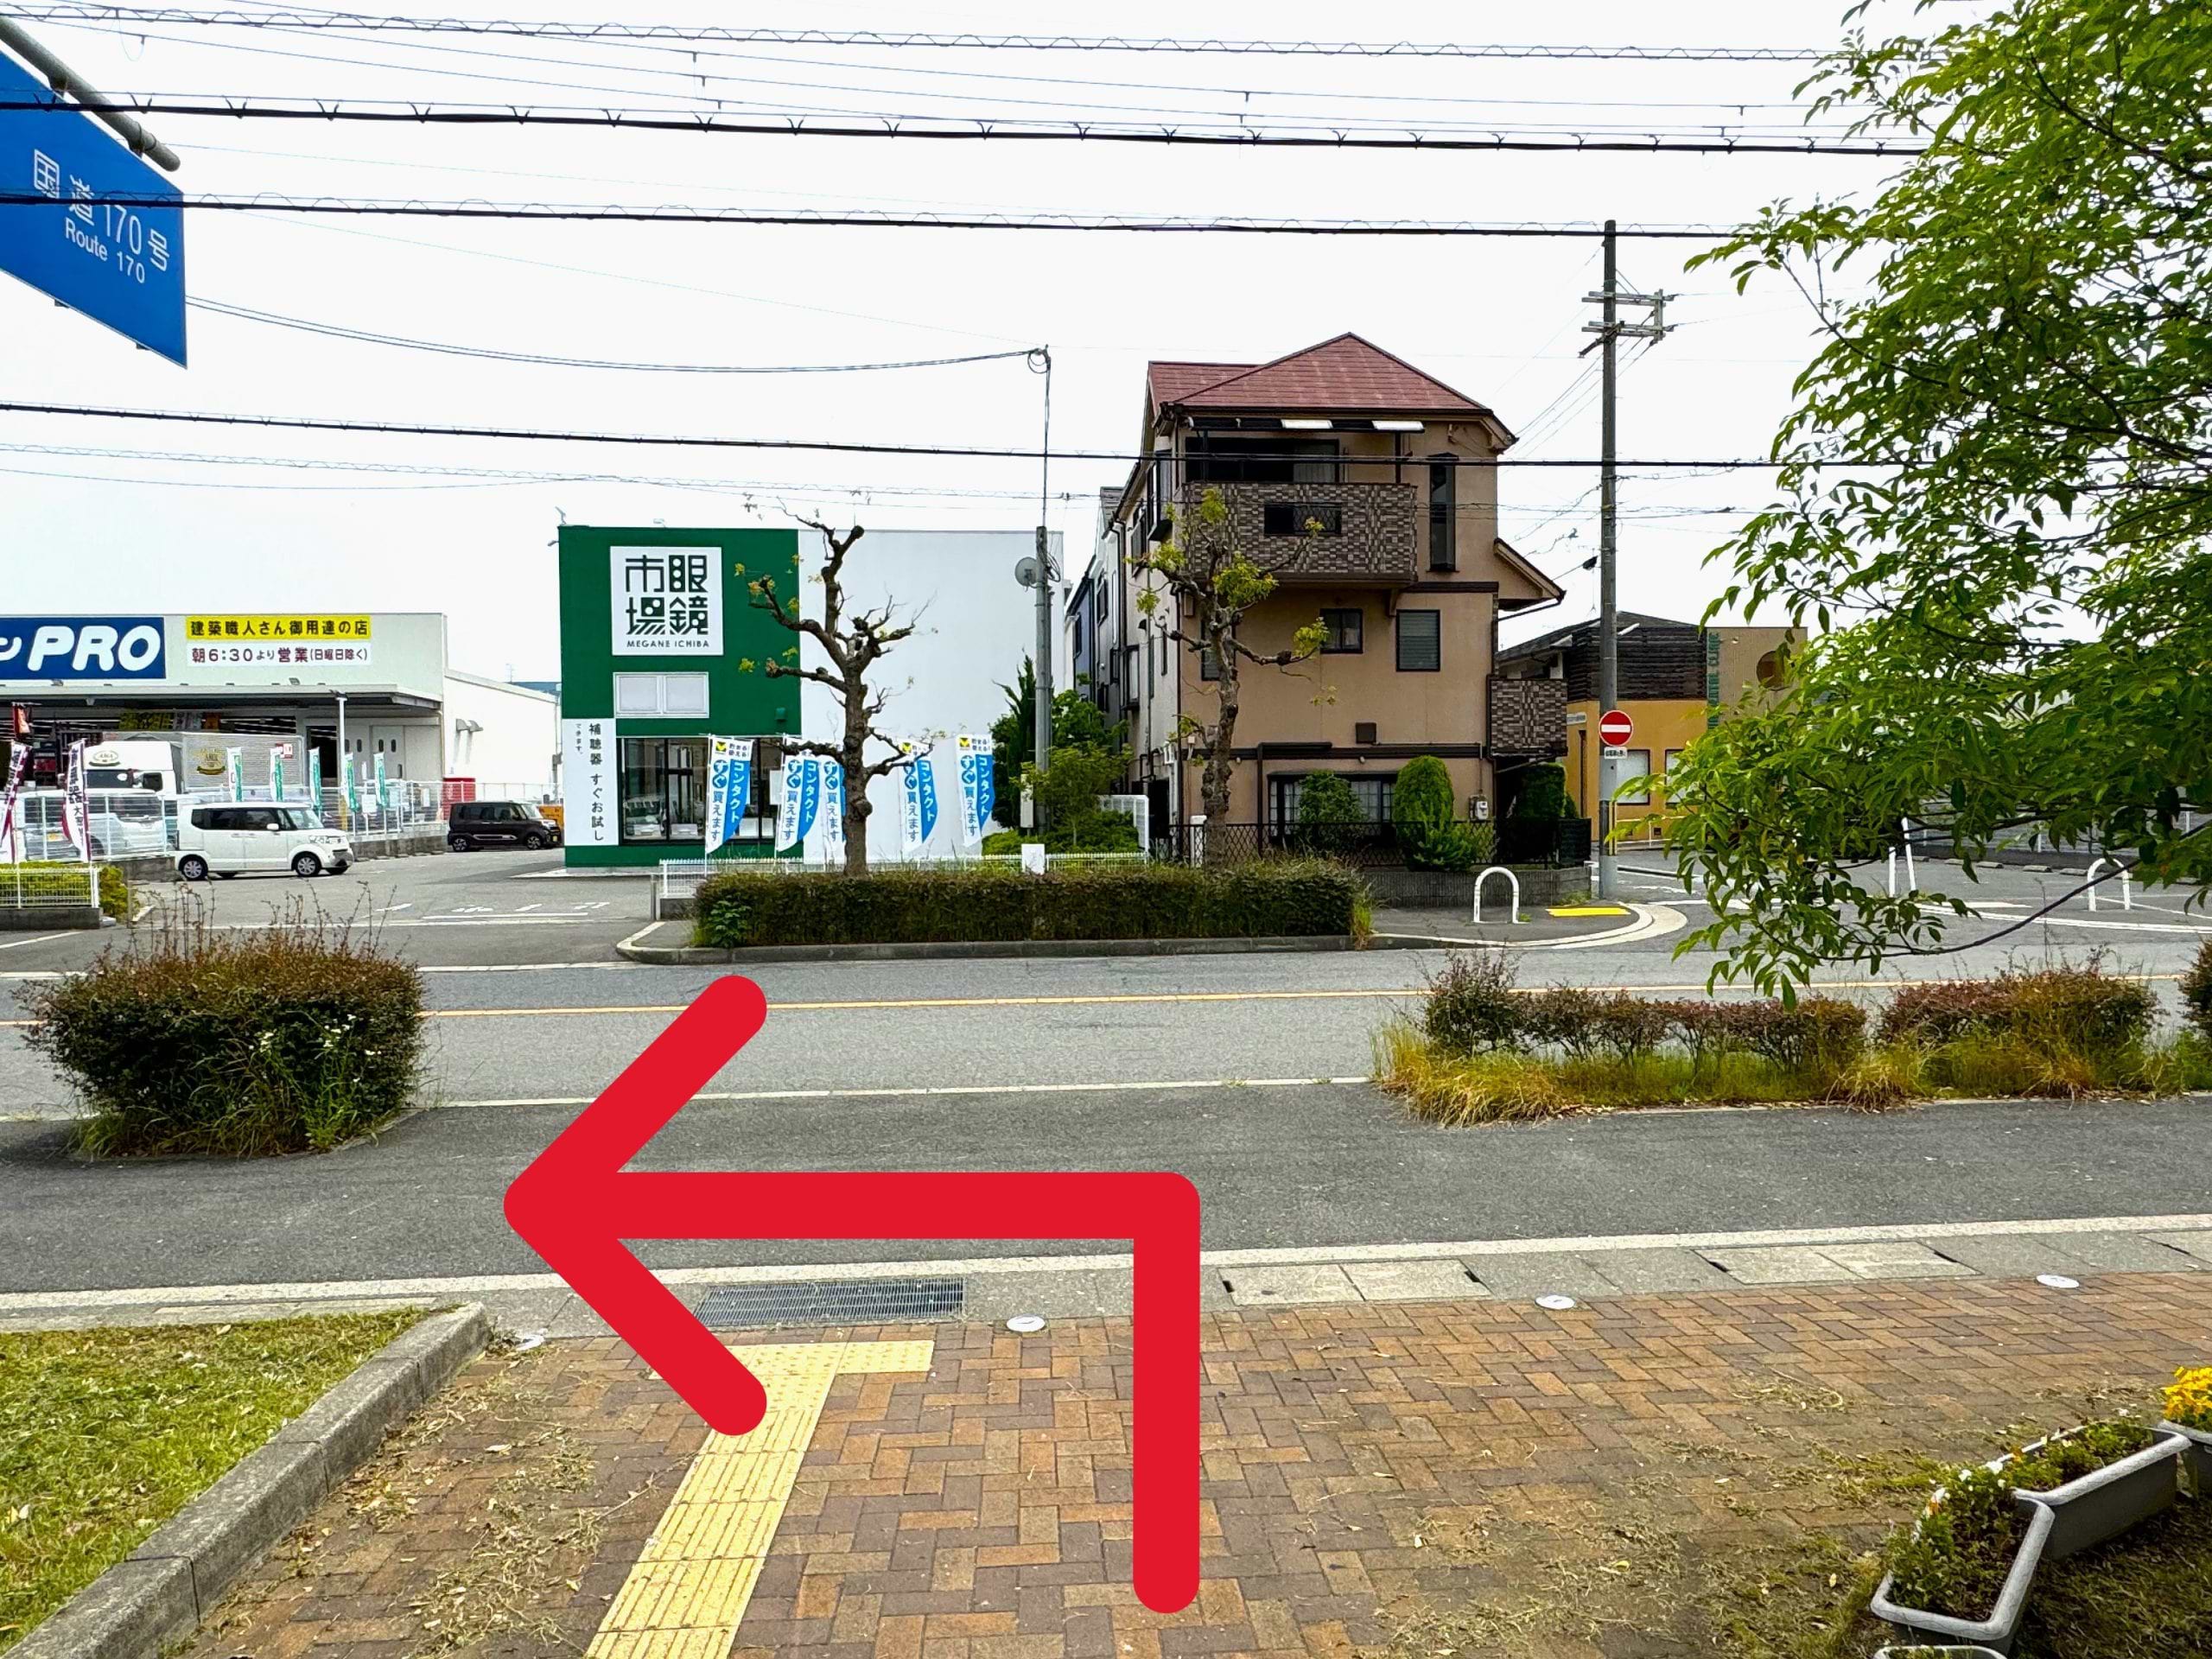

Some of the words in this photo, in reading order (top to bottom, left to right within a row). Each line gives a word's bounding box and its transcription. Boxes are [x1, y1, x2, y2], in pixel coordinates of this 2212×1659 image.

[35, 149, 170, 271] 国道170号
[65, 218, 108, 262] Route
[117, 251, 145, 283] 170
[190, 620, 368, 637] 建築職人さん御用達の店
[626, 639, 671, 648] MEGANE
[674, 639, 709, 648] ICHIBA
[590, 773, 605, 842] すぐお試し
[710, 760, 728, 842] すぐ買えます
[730, 761, 745, 823] コンタクト
[804, 762, 817, 823] コンタクト
[920, 761, 936, 823] コンタクト
[979, 756, 990, 817] コンタクト
